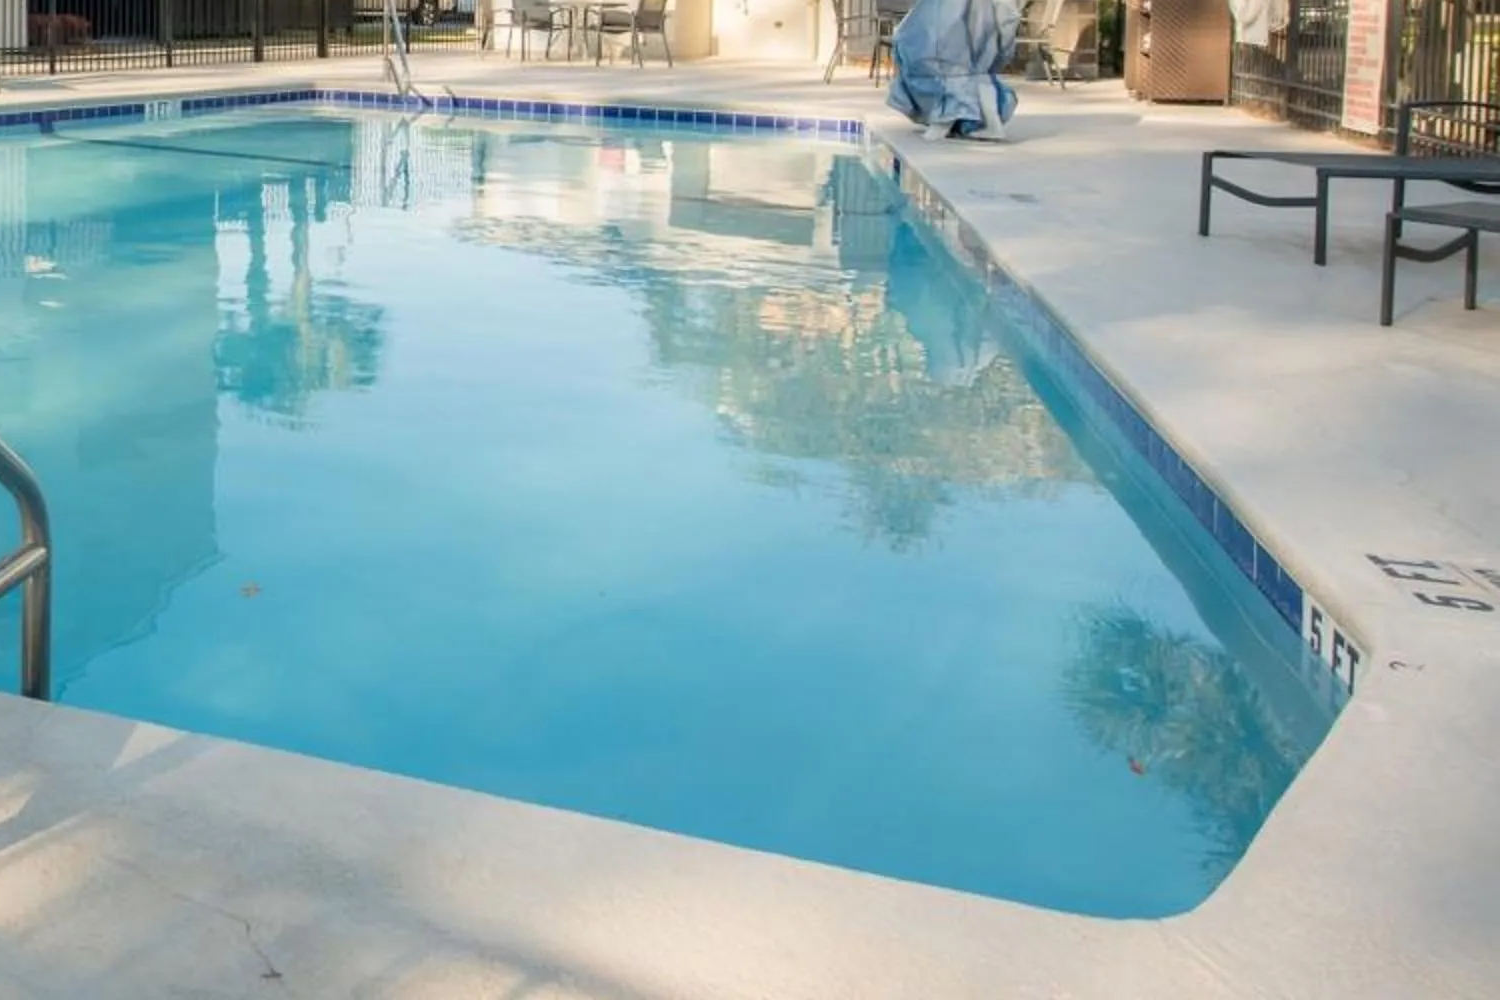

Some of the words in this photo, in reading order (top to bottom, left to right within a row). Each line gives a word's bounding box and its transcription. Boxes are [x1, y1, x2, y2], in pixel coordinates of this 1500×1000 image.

[1363, 553, 1462, 586] FT
[1412, 591, 1495, 612] 5
[1310, 605, 1323, 656] 5
[1331, 628, 1359, 697] FT
